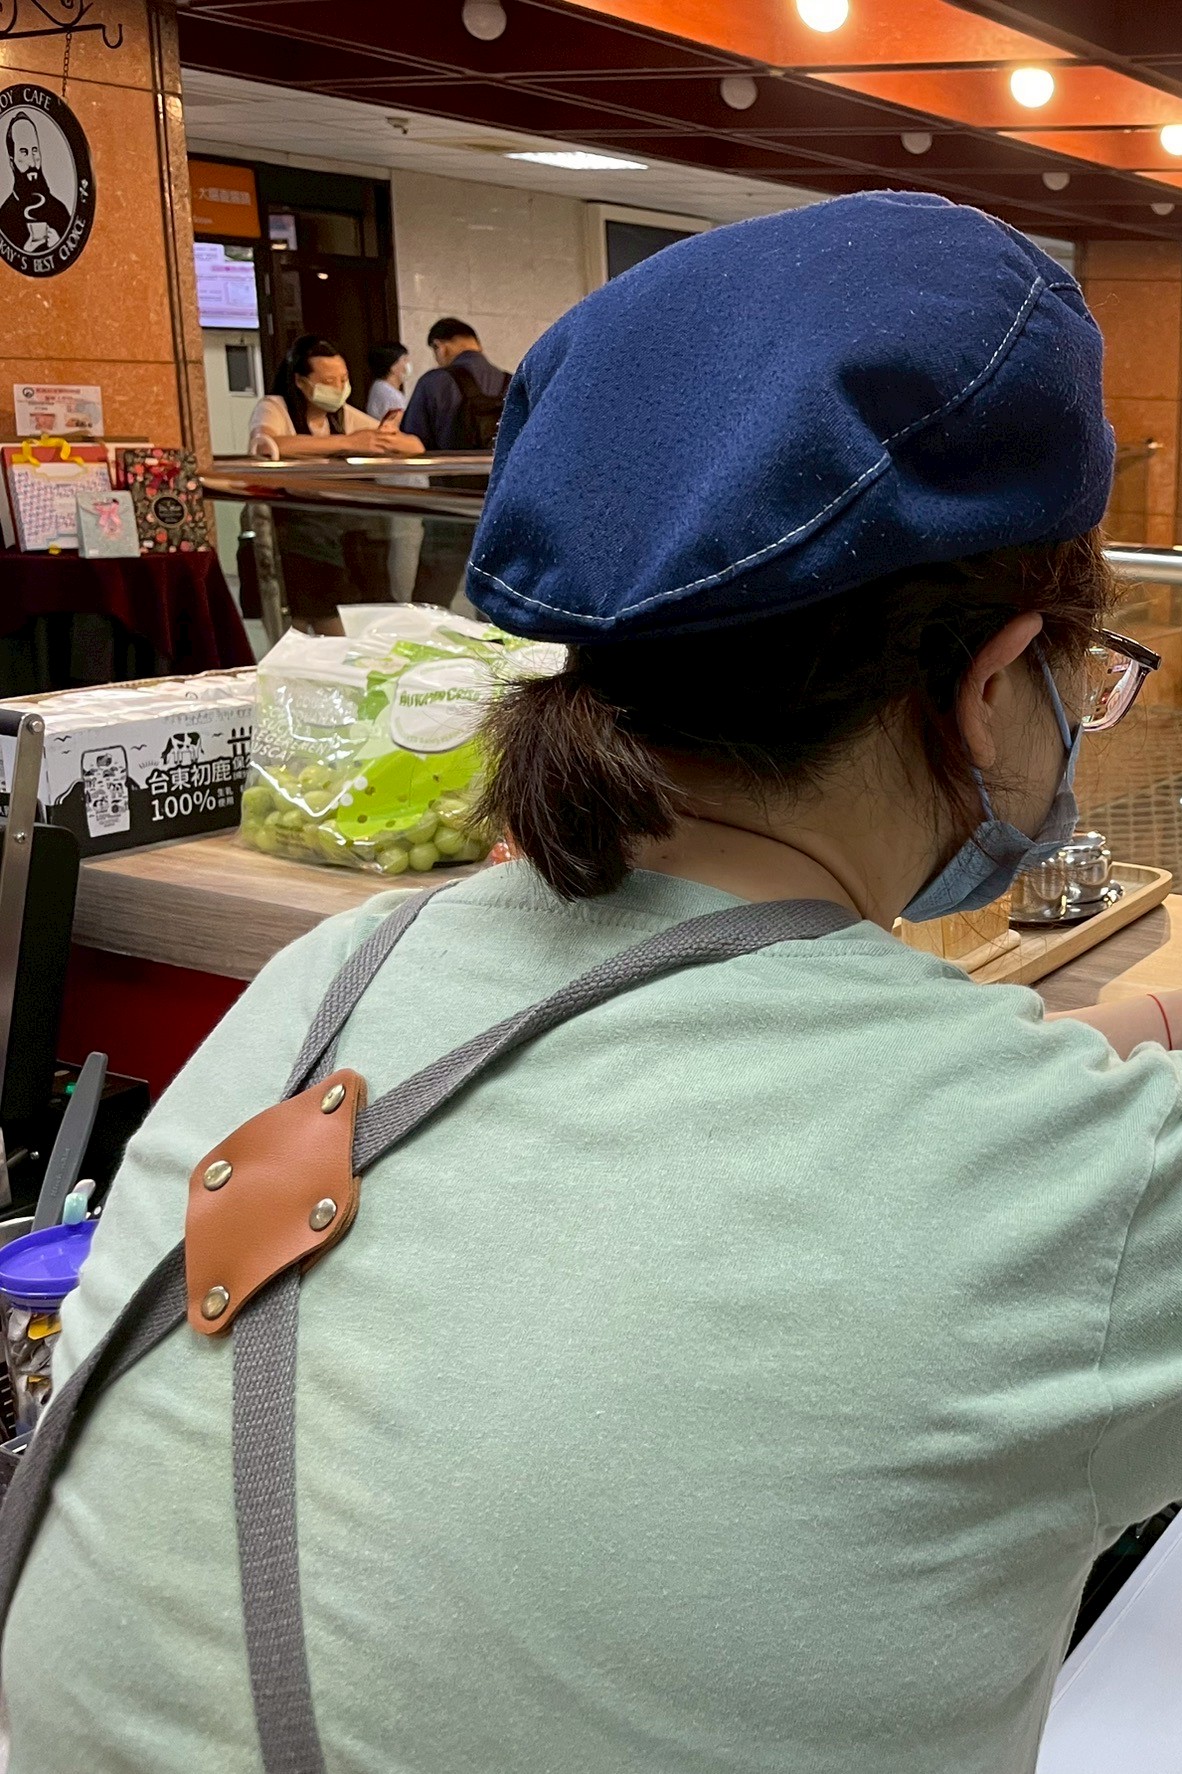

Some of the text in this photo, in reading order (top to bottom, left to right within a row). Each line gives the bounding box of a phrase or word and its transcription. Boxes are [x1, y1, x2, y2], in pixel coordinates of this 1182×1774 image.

[0, 88, 51, 112] OY CAFE
[0, 215, 86, 272] KAY'S BEST CHOICE
[148, 759, 233, 796] 台東初鹿
[151, 788, 216, 821] 100%
